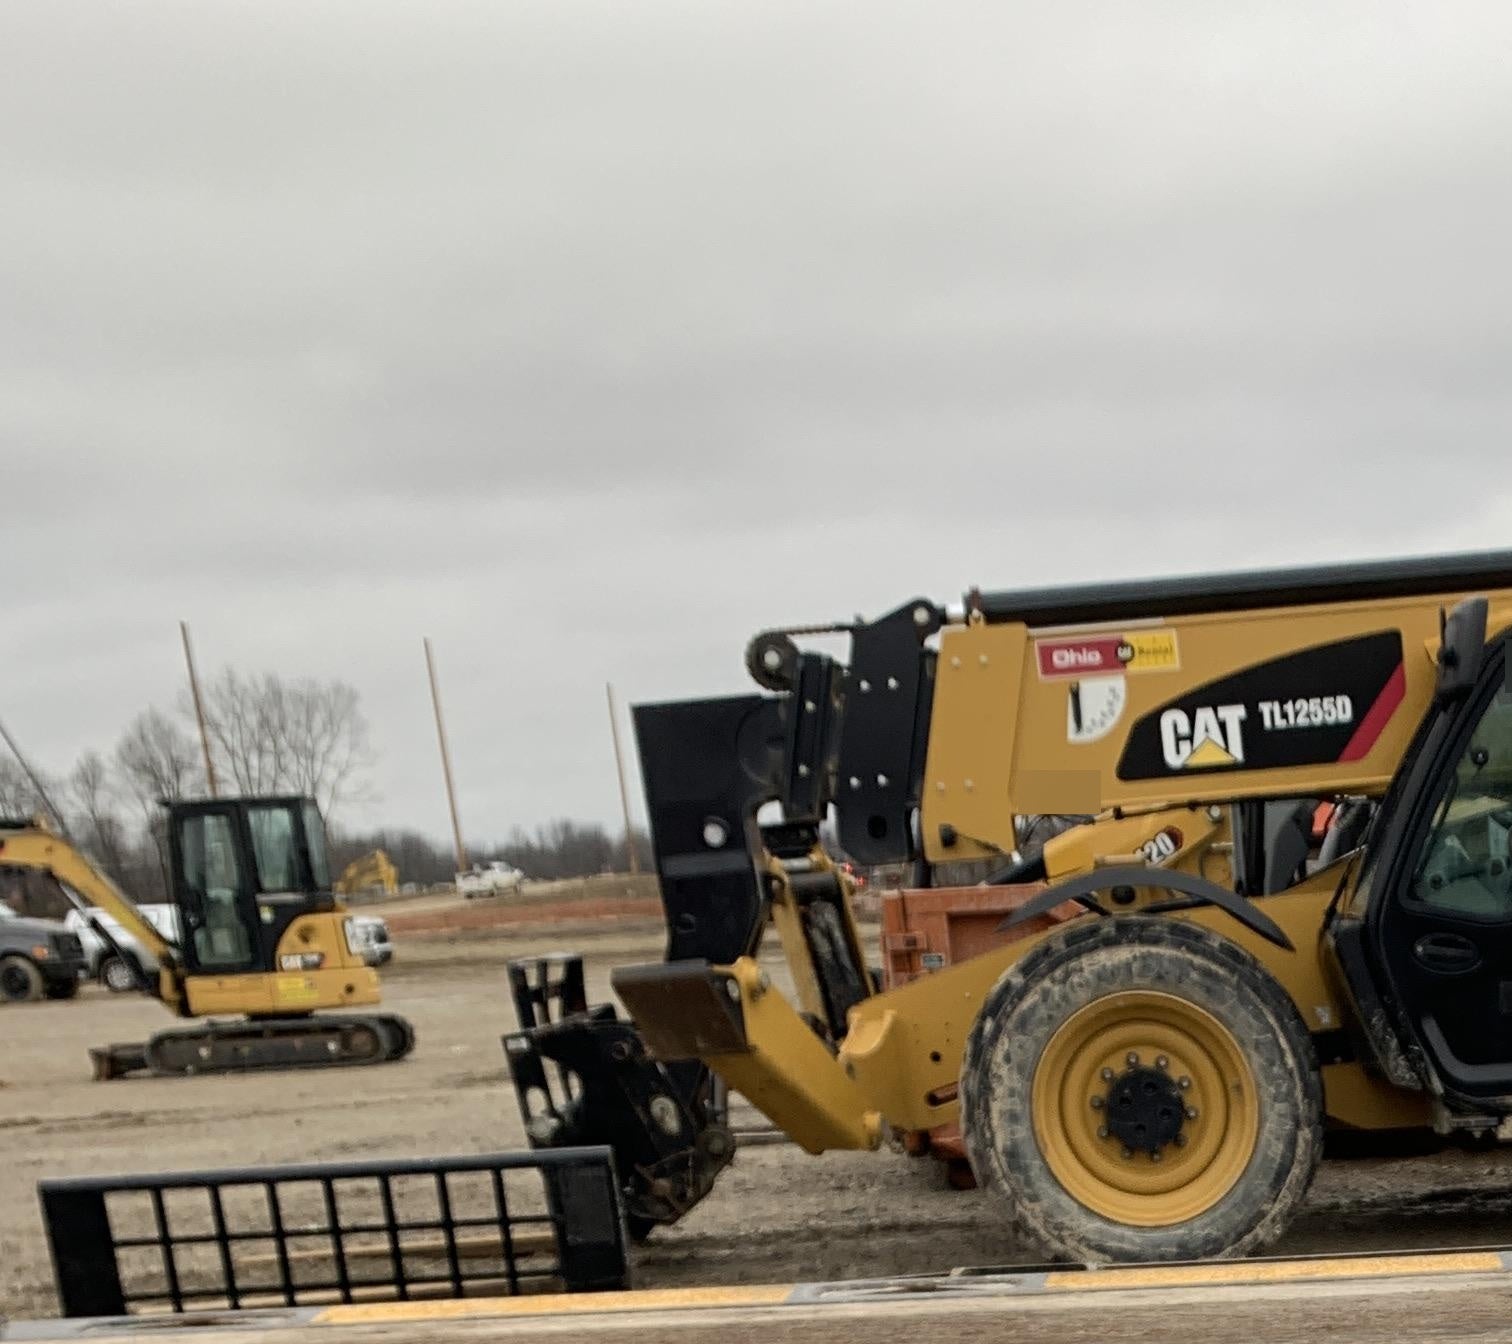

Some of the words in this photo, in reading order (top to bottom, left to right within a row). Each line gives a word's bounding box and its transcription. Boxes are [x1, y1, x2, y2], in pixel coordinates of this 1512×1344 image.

[1052, 648, 1103, 668] Ohio
[1160, 705, 1246, 769] CAT
[1258, 695, 1353, 731] TL1255D
